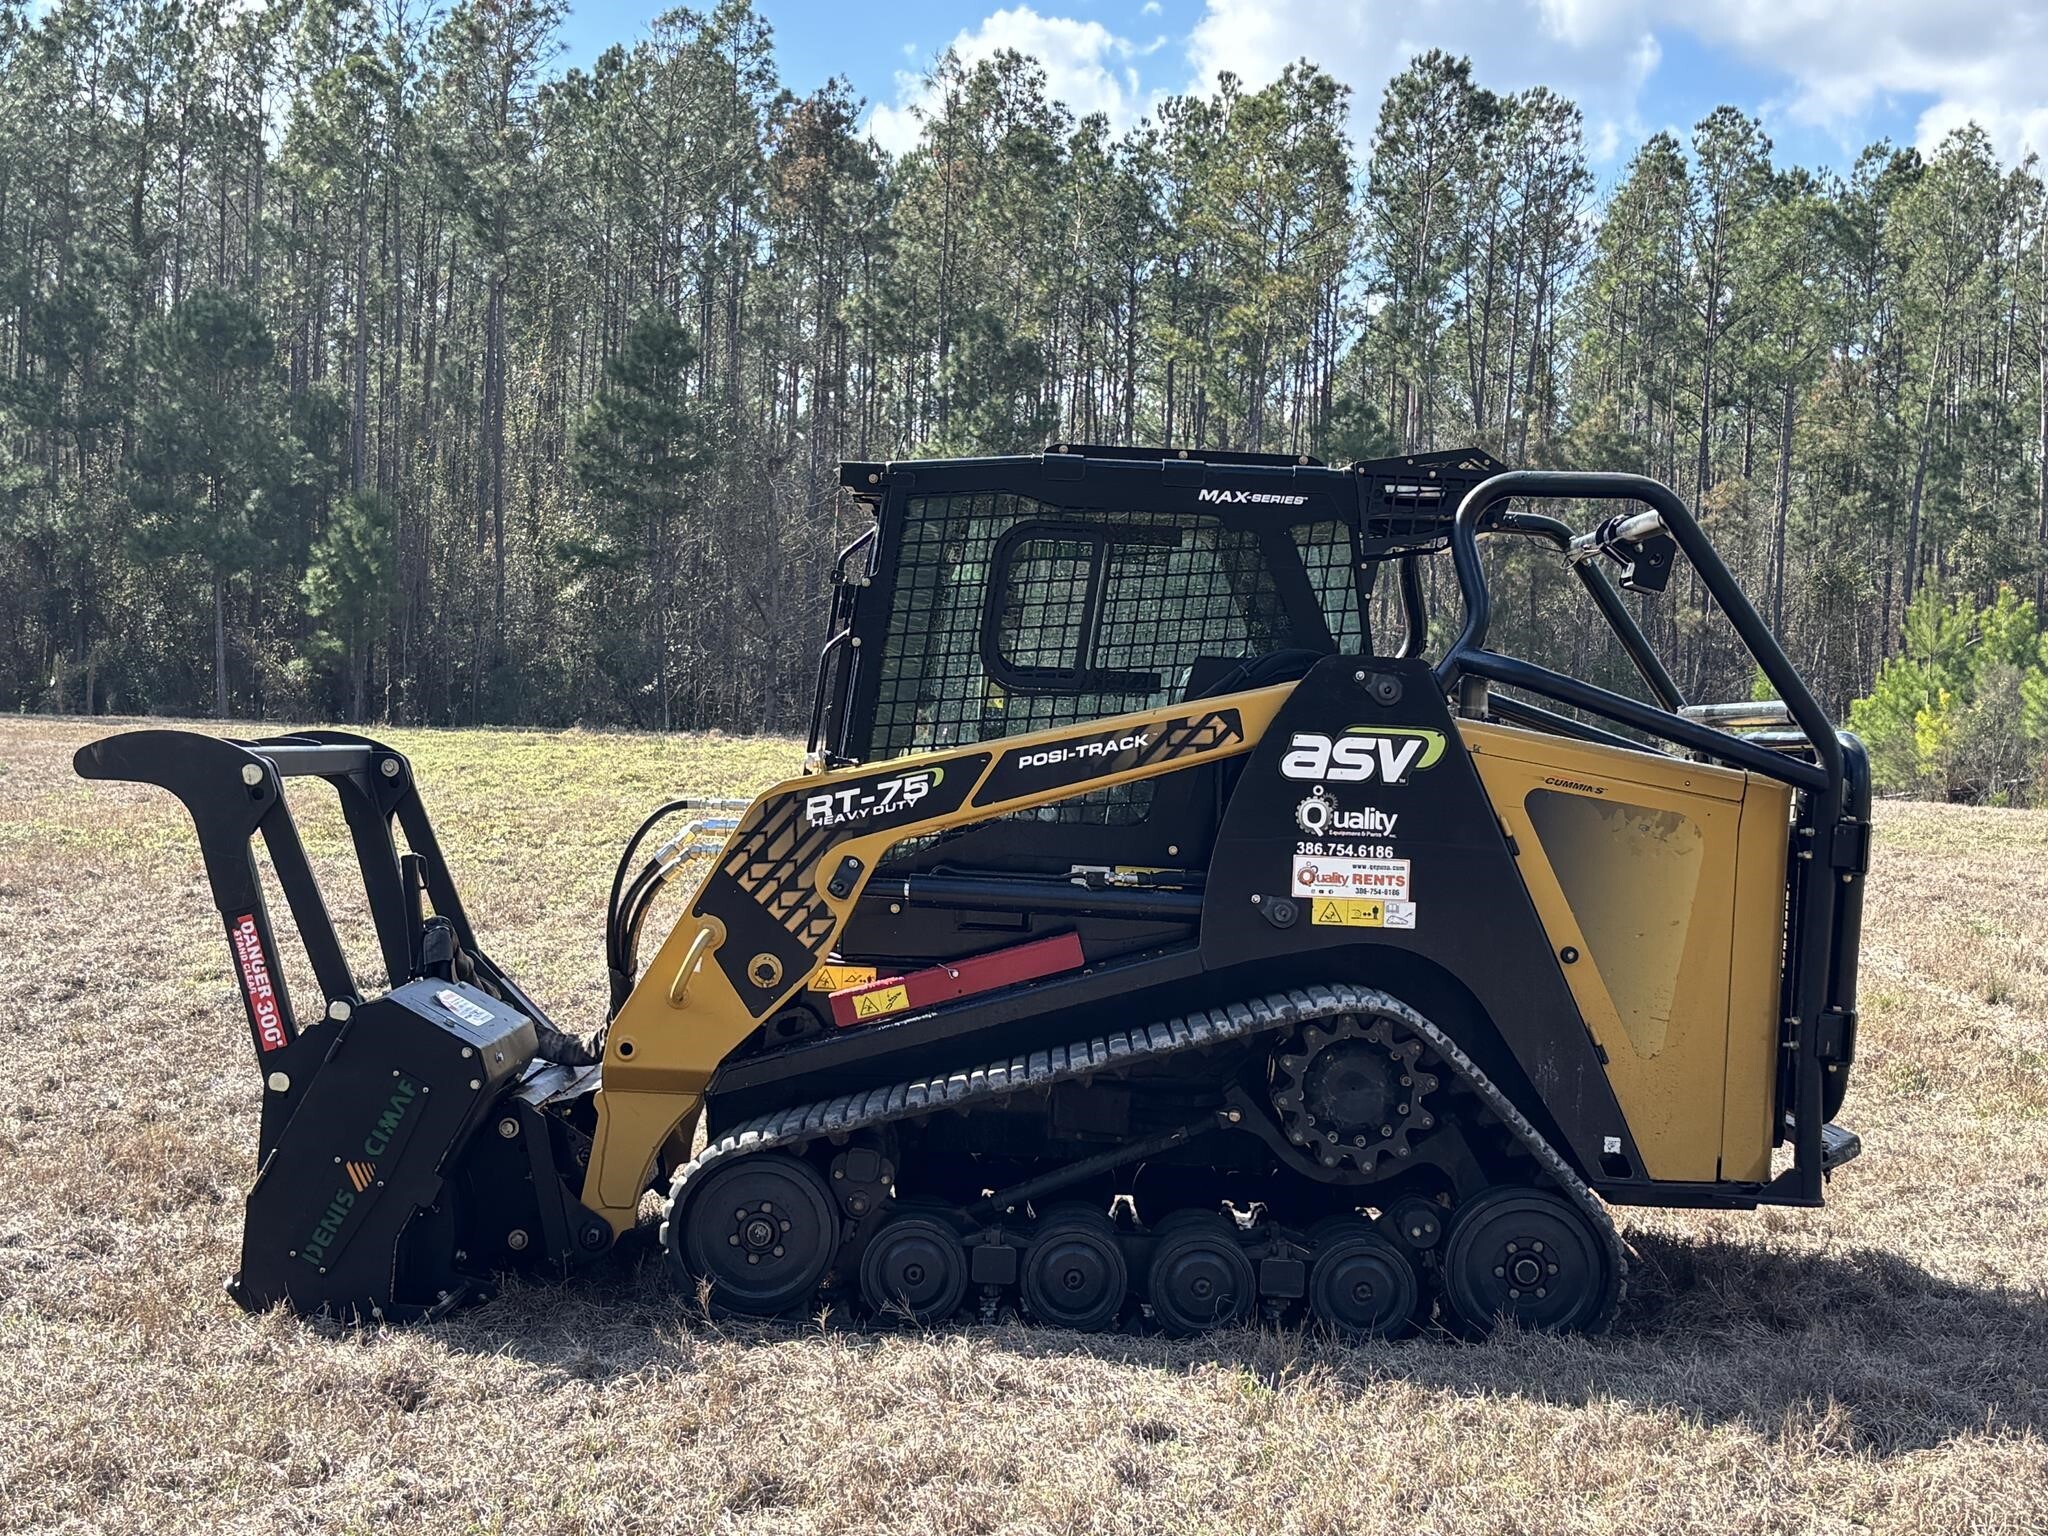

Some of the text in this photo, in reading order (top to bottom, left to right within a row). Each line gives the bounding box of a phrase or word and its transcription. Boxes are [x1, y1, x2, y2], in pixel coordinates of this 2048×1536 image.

[1198, 489, 1305, 505] MAX-SERIES
[1018, 733, 1149, 769] POSI-TRACK
[806, 773, 930, 820] RT-75
[811, 797, 918, 827] HEAVY DUTY
[1301, 802, 1398, 837] Quality
[1296, 841, 1394, 858] 386.754.6186
[1297, 866, 1350, 887] Quality
[1352, 873, 1406, 887] RENTS
[240, 920, 273, 999] DANGER
[363, 1078, 418, 1157] CIMAF
